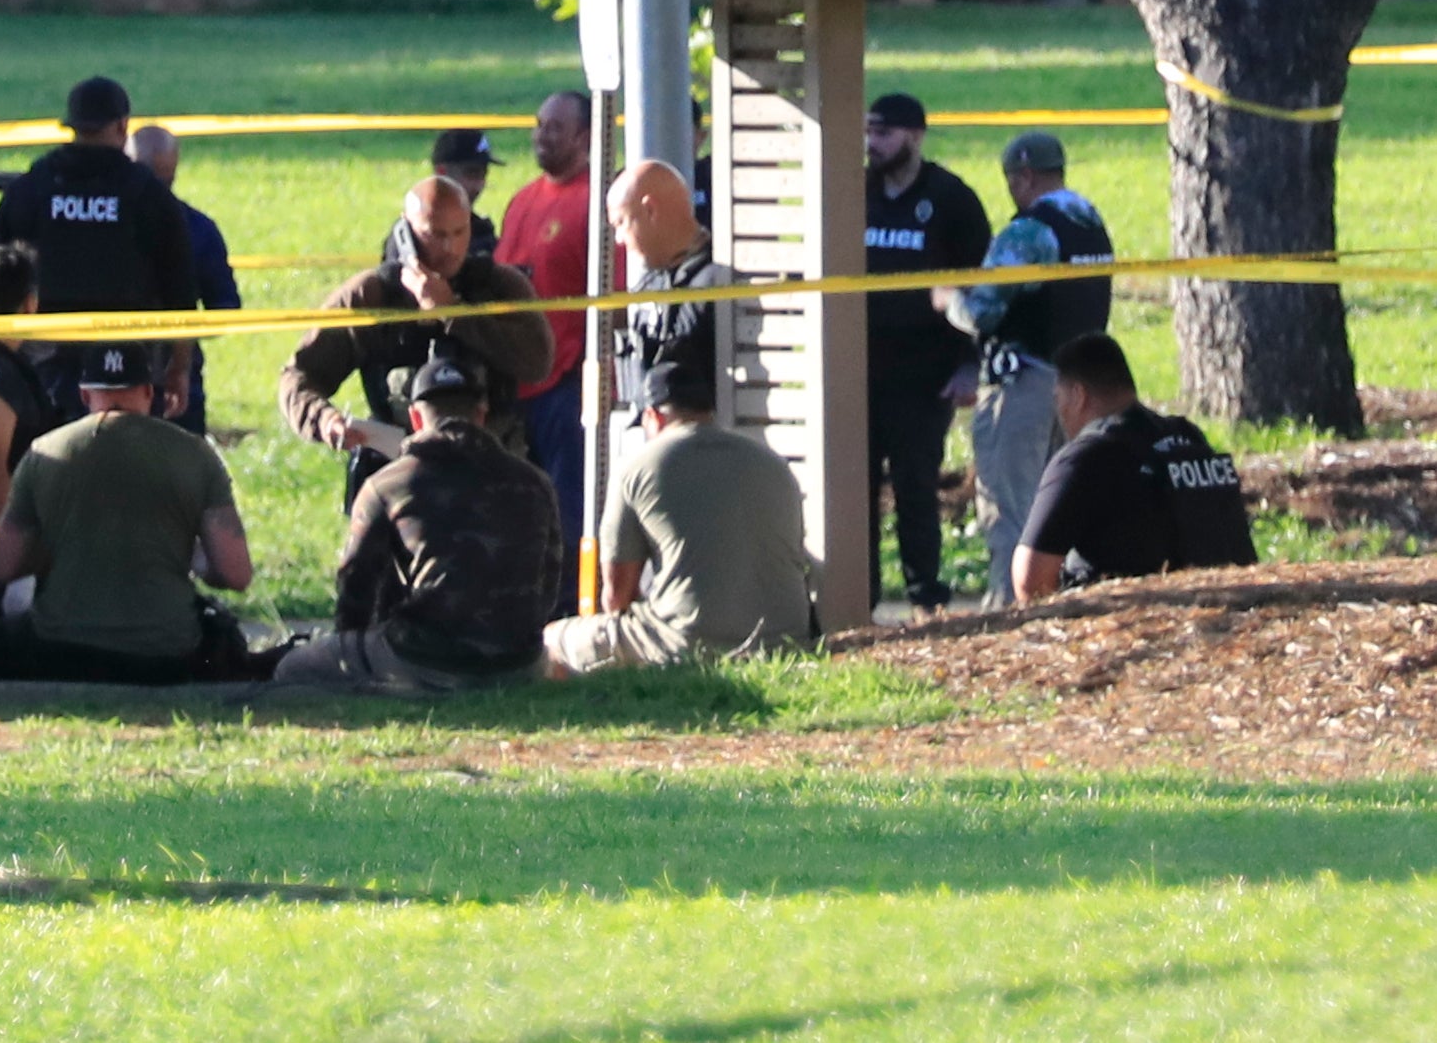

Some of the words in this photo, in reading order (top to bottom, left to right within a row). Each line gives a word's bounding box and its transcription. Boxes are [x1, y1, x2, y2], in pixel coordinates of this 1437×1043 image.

[51, 195, 119, 222] POLICE
[864, 226, 925, 251] OLICE
[1167, 457, 1238, 489] POLICE
